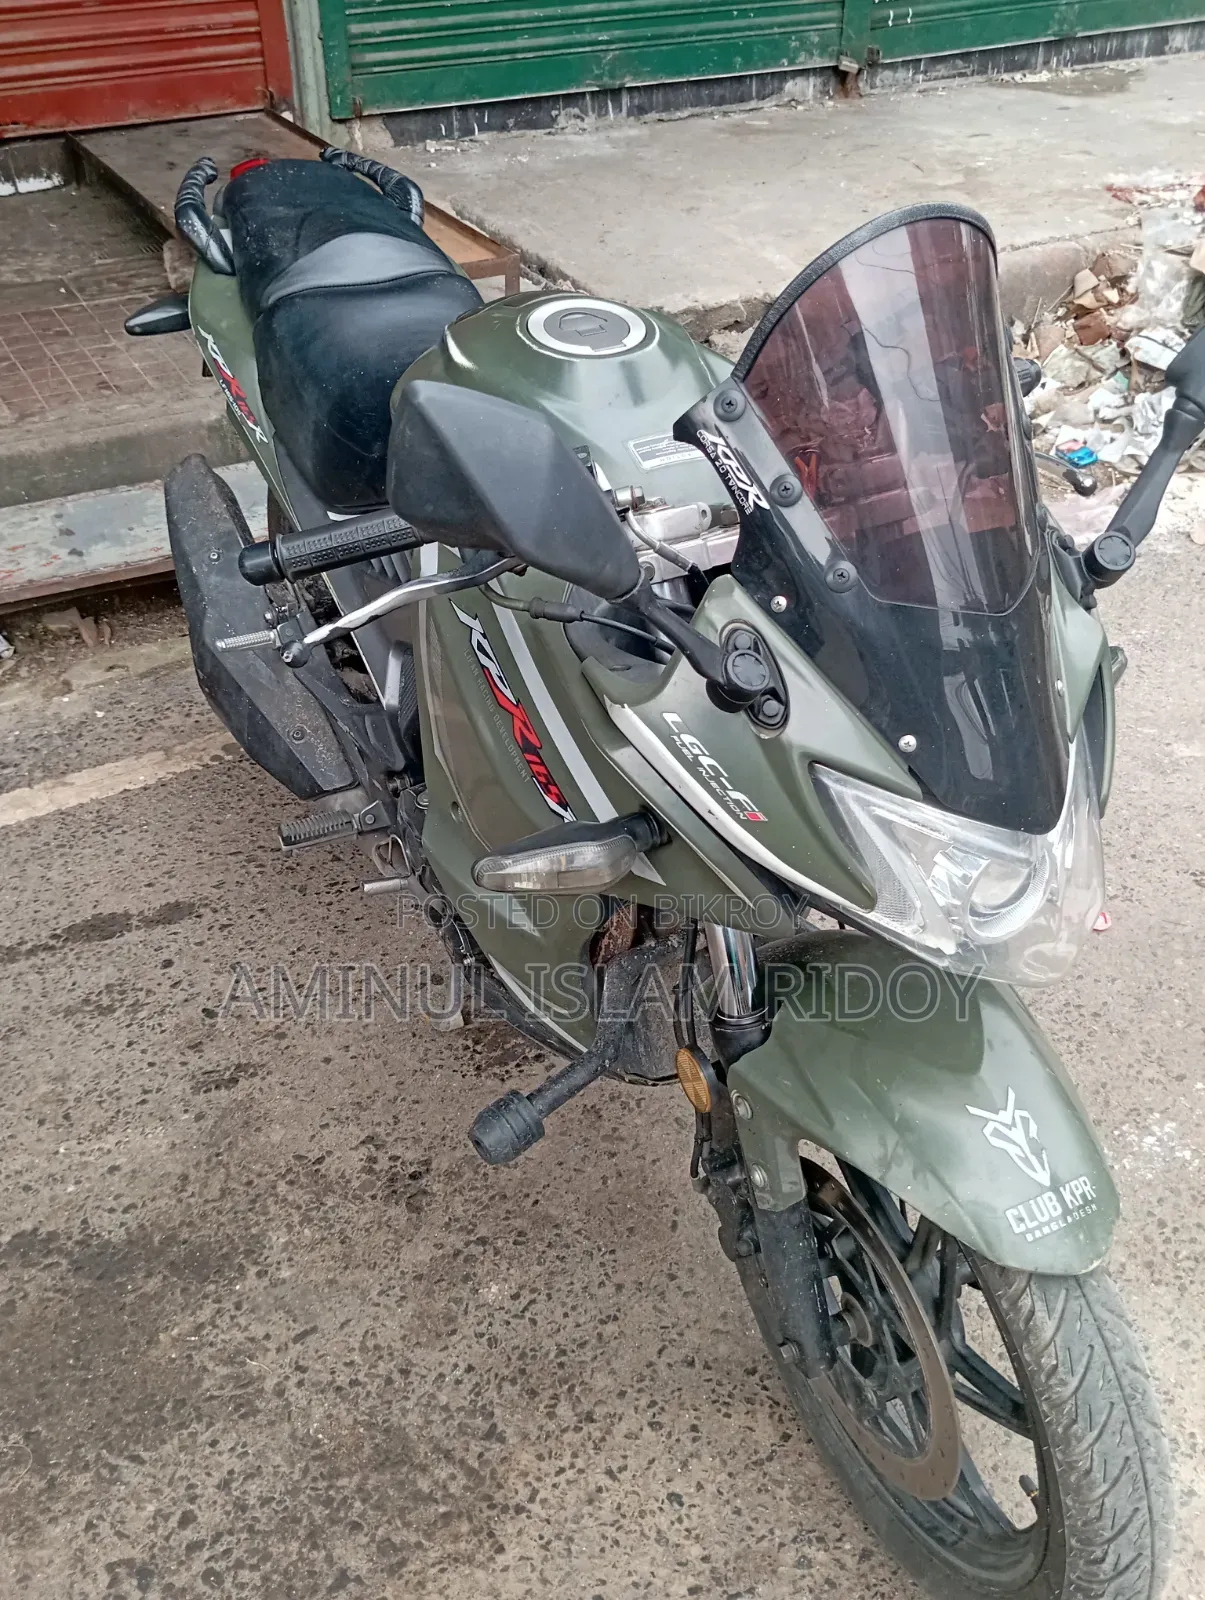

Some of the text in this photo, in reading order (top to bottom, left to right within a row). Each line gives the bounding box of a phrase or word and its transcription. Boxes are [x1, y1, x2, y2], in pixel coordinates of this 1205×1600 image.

[696, 430, 717, 459] CORSA
[698, 429, 770, 510] KPR
[463, 648, 531, 783] LIFAN RACING DEVELOPMENT
[670, 735, 748, 820] FUEL INJECTION
[1004, 1191, 1063, 1235] CLUB
[1025, 1203, 1098, 1243] BANGLADESH
